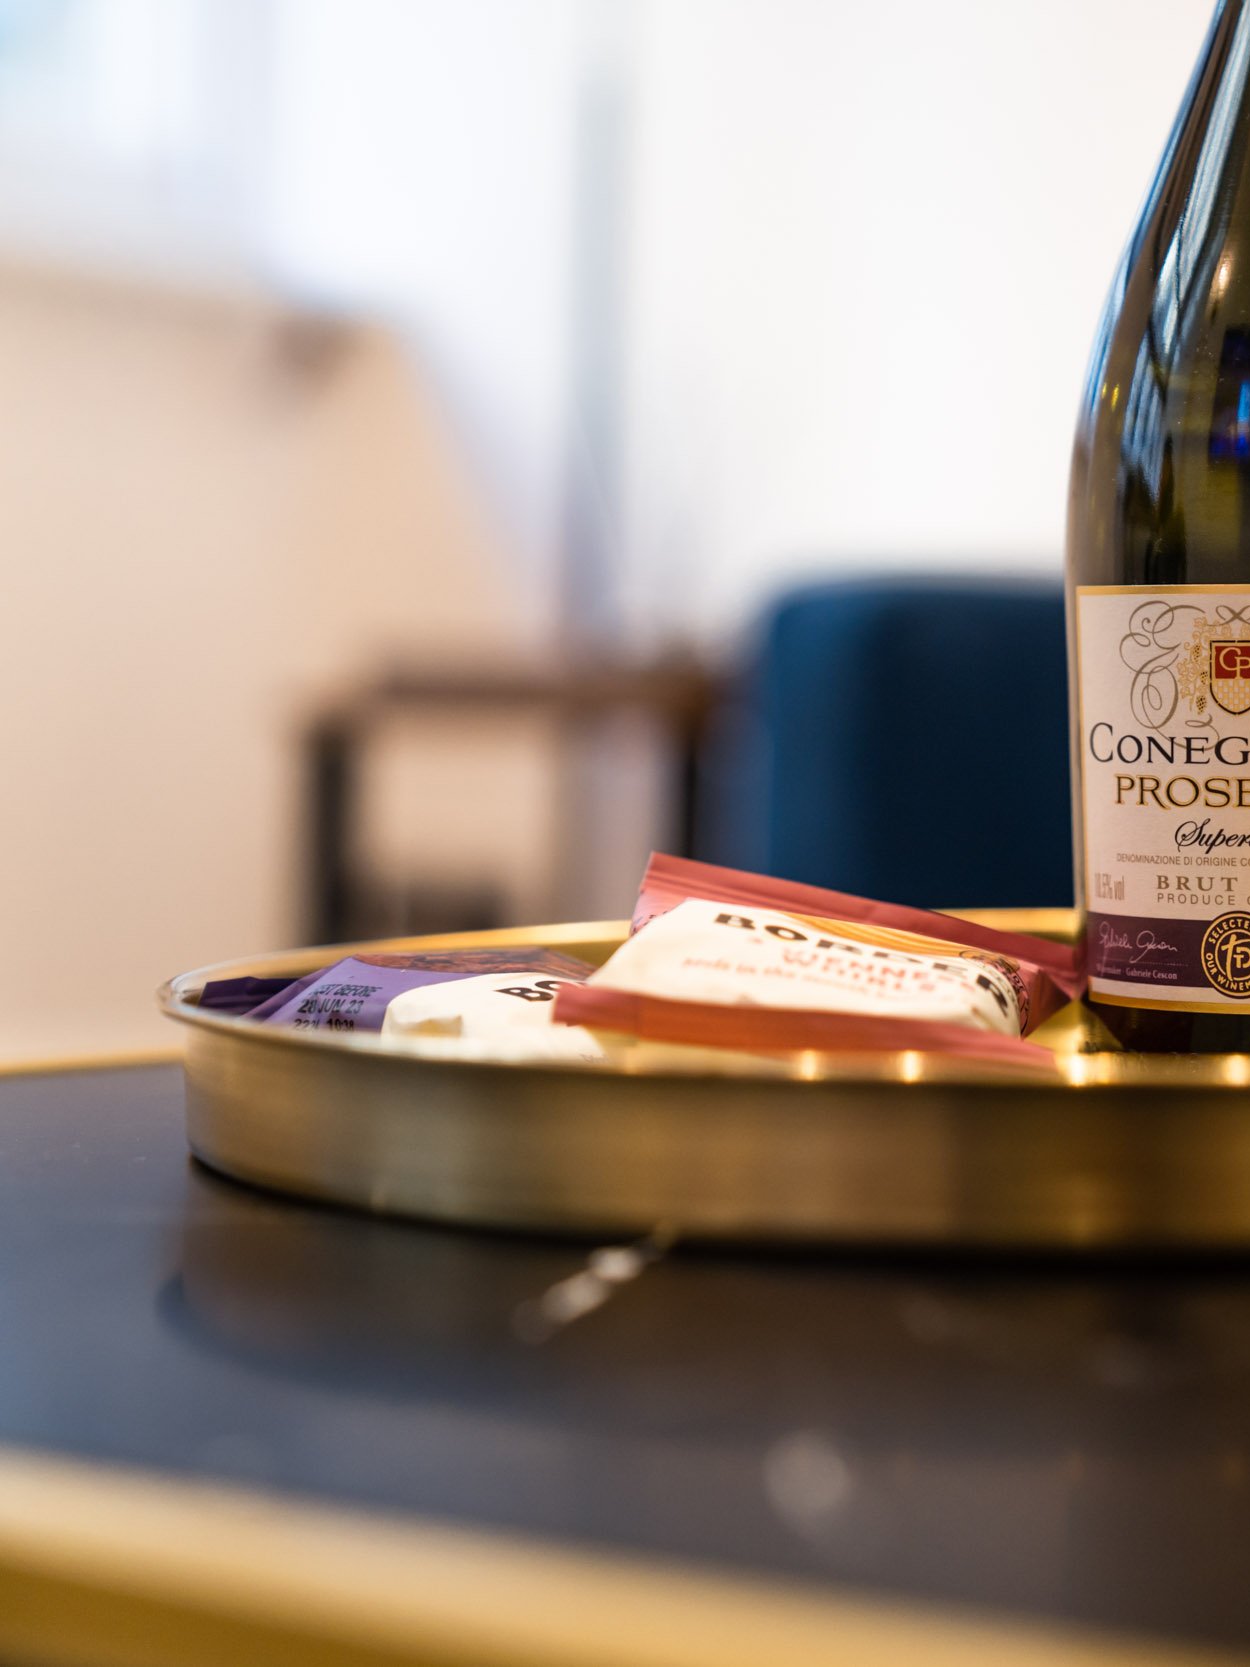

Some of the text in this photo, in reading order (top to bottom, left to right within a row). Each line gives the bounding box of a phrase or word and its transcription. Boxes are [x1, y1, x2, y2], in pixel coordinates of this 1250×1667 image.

[1117, 853, 1181, 866] DENOMINAZIONE
[1183, 856, 1193, 866] DI
[1195, 857, 1237, 867] ORIGINE
[1156, 874, 1238, 892] BRUT
[1157, 893, 1236, 906] PRODUCE
[714, 912, 1009, 1018] BORDER
[1205, 952, 1218, 975] OUR
[318, 998, 345, 1014] JUN
[344, 1000, 364, 1014] 23
